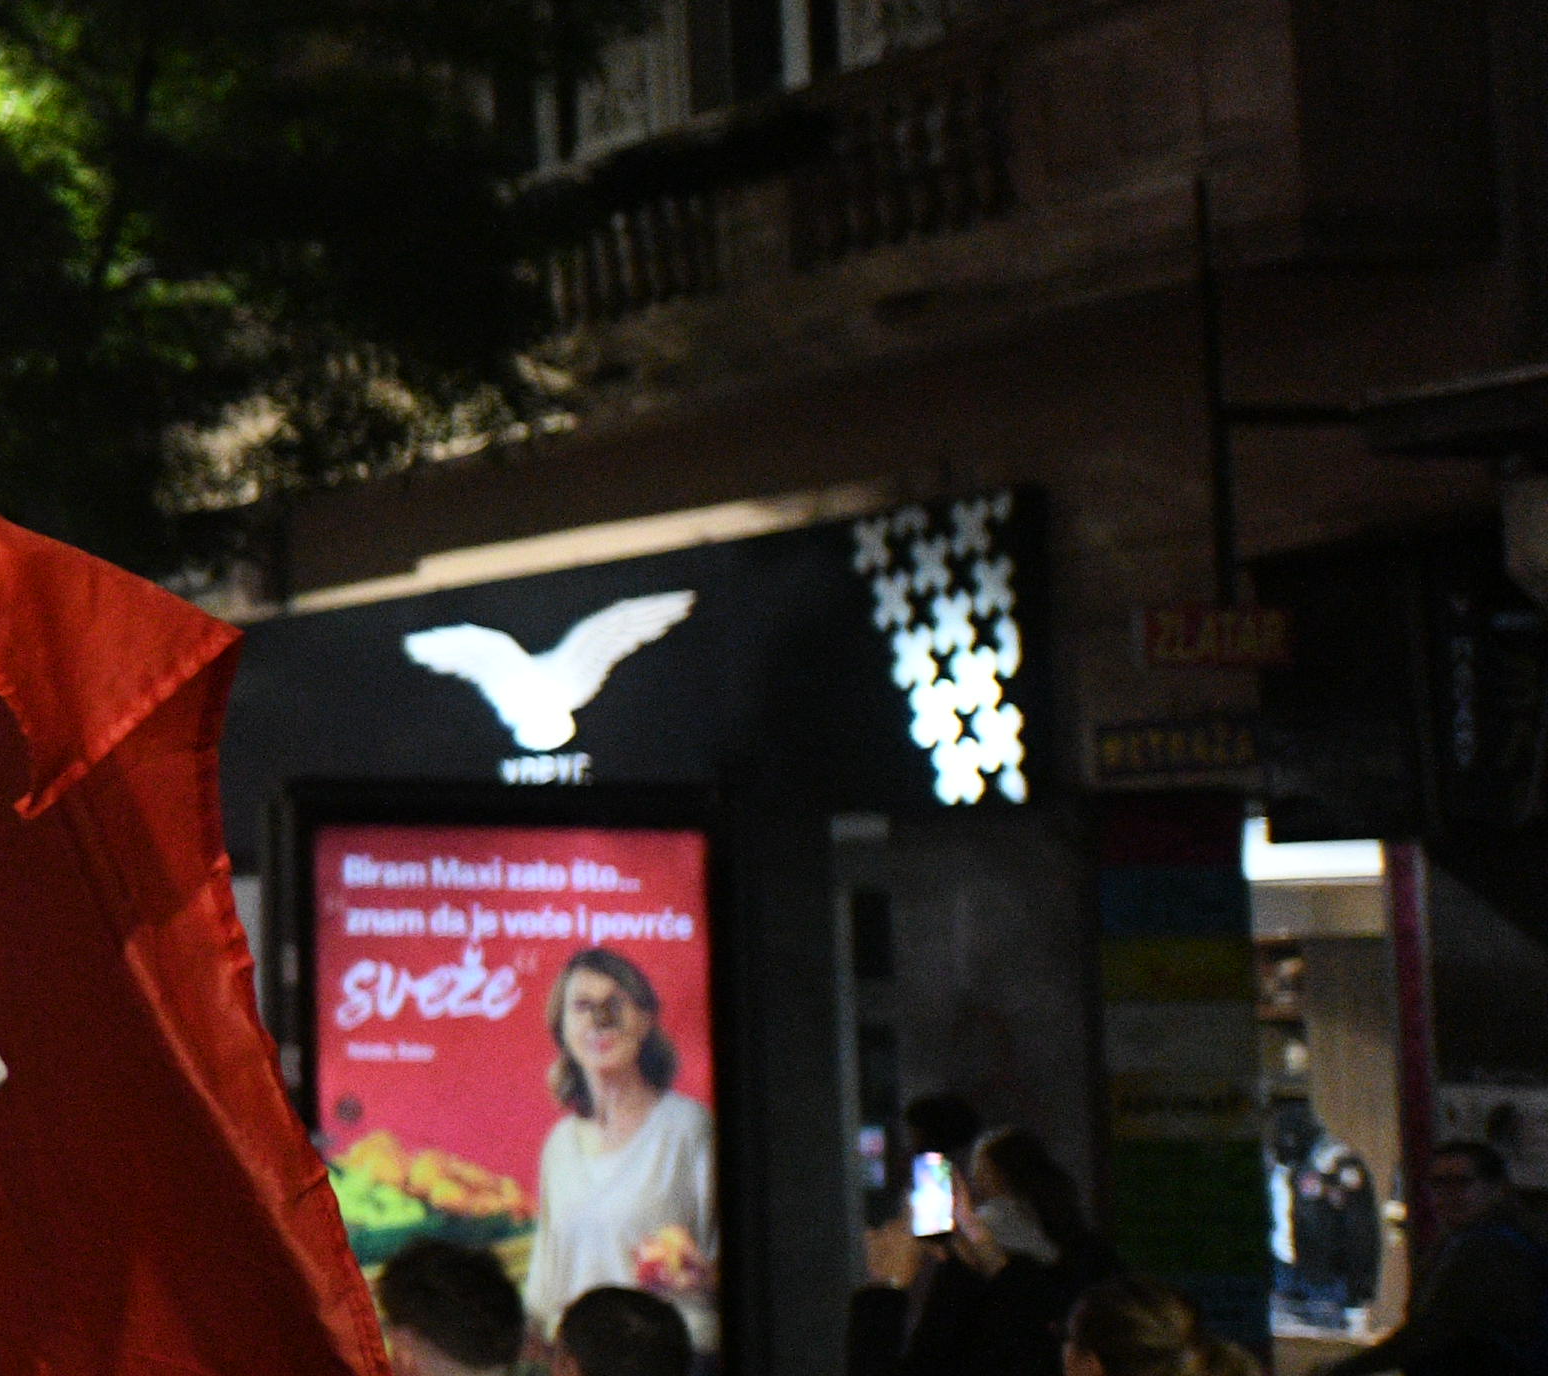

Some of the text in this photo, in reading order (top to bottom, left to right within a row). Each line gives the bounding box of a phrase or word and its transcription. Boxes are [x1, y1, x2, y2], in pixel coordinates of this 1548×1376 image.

[1154, 608, 1286, 660] ZLATAR
[342, 853, 426, 889] Biram
[430, 855, 502, 891] Maxi
[505, 859, 568, 892] zato
[346, 903, 695, 947] znam da je voće i povrće
